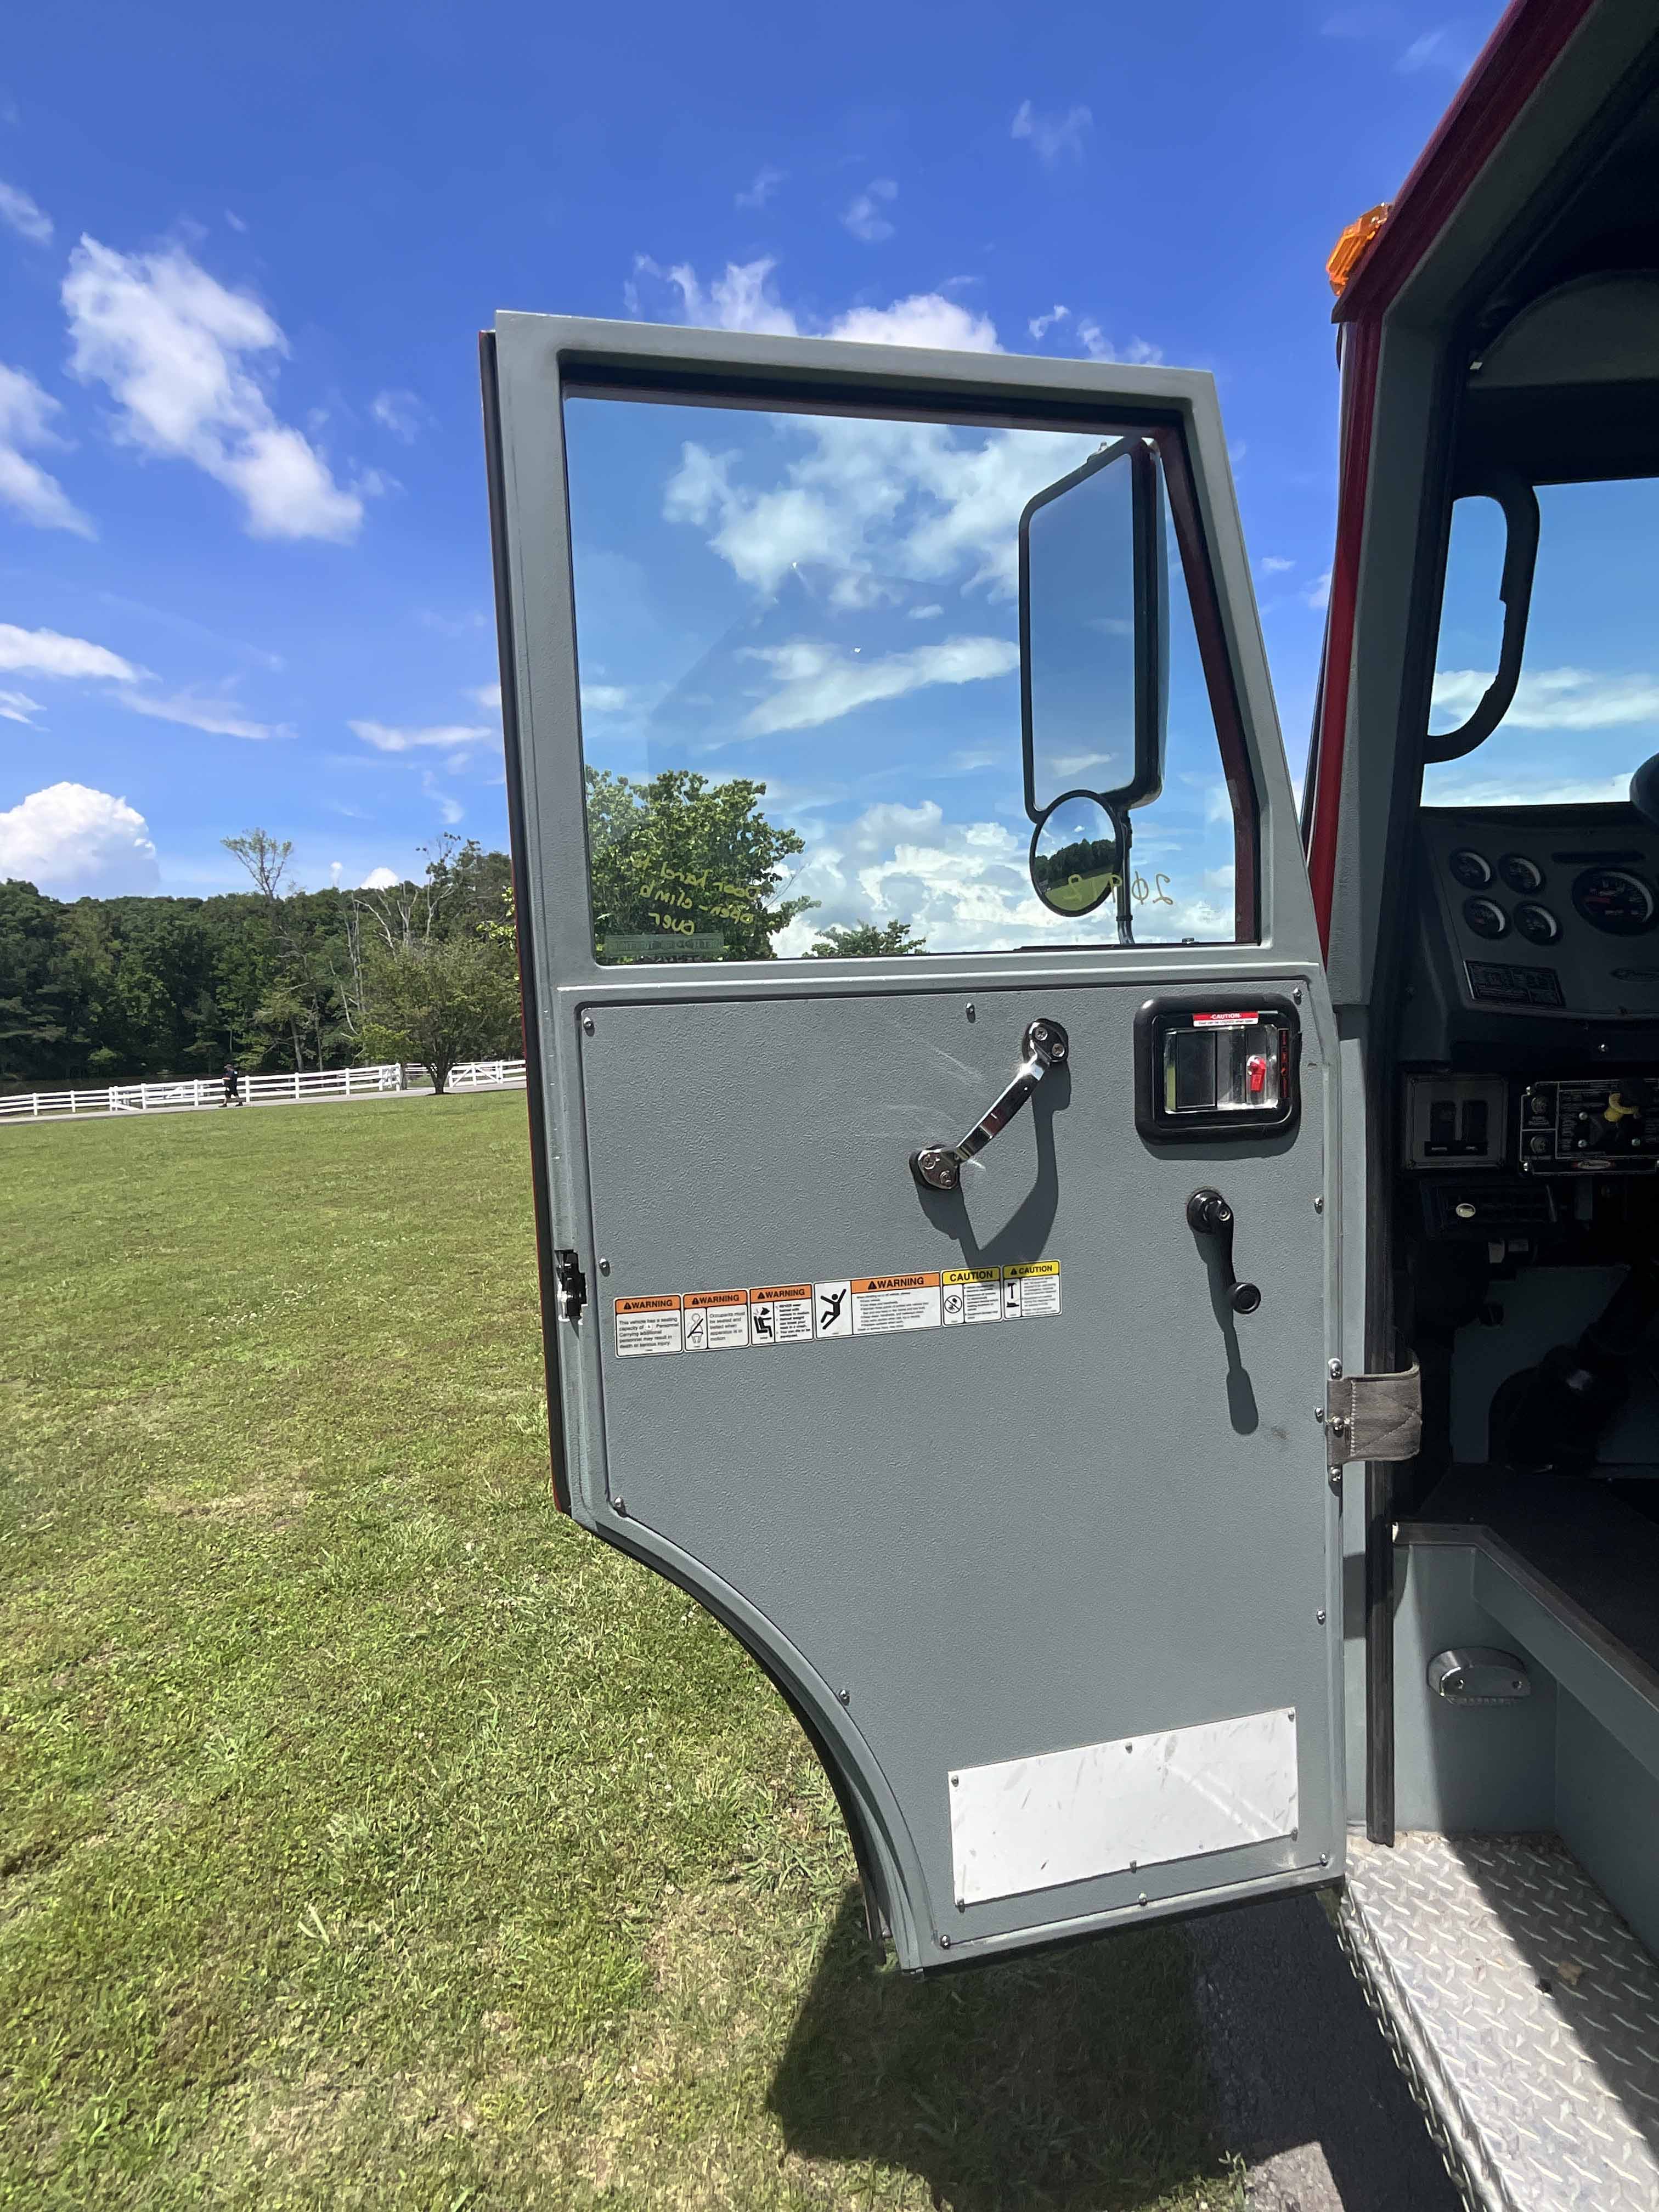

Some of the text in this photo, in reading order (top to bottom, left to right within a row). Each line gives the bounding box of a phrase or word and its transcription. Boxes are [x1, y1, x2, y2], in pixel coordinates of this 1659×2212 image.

[1019, 1265, 1052, 1274] CAUTION
[950, 1271, 994, 1282] CAUTION
[877, 1277, 924, 1288] WARNING
[765, 1289, 805, 1299] WARNING
[699, 1295, 740, 1304] WARNING
[631, 1300, 673, 1309] WARNING
